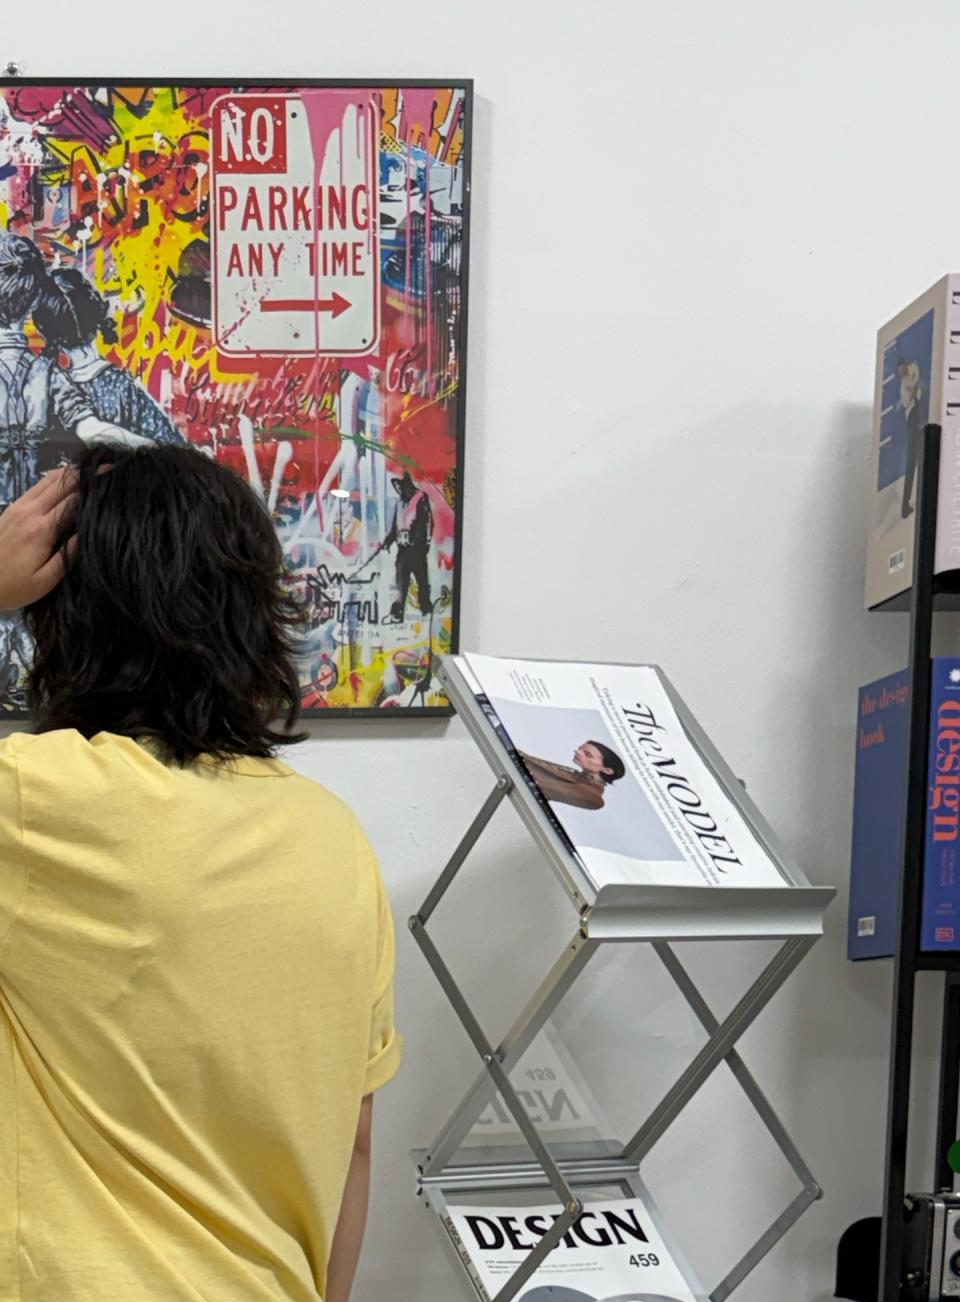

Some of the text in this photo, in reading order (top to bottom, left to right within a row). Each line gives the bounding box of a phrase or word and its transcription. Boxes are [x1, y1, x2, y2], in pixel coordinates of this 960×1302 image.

[220, 103, 276, 165] NO
[218, 185, 372, 232] PARKING
[226, 241, 365, 278] ANY TIME
[644, 751, 743, 874] MODEL
[628, 1253, 661, 1269] 459
